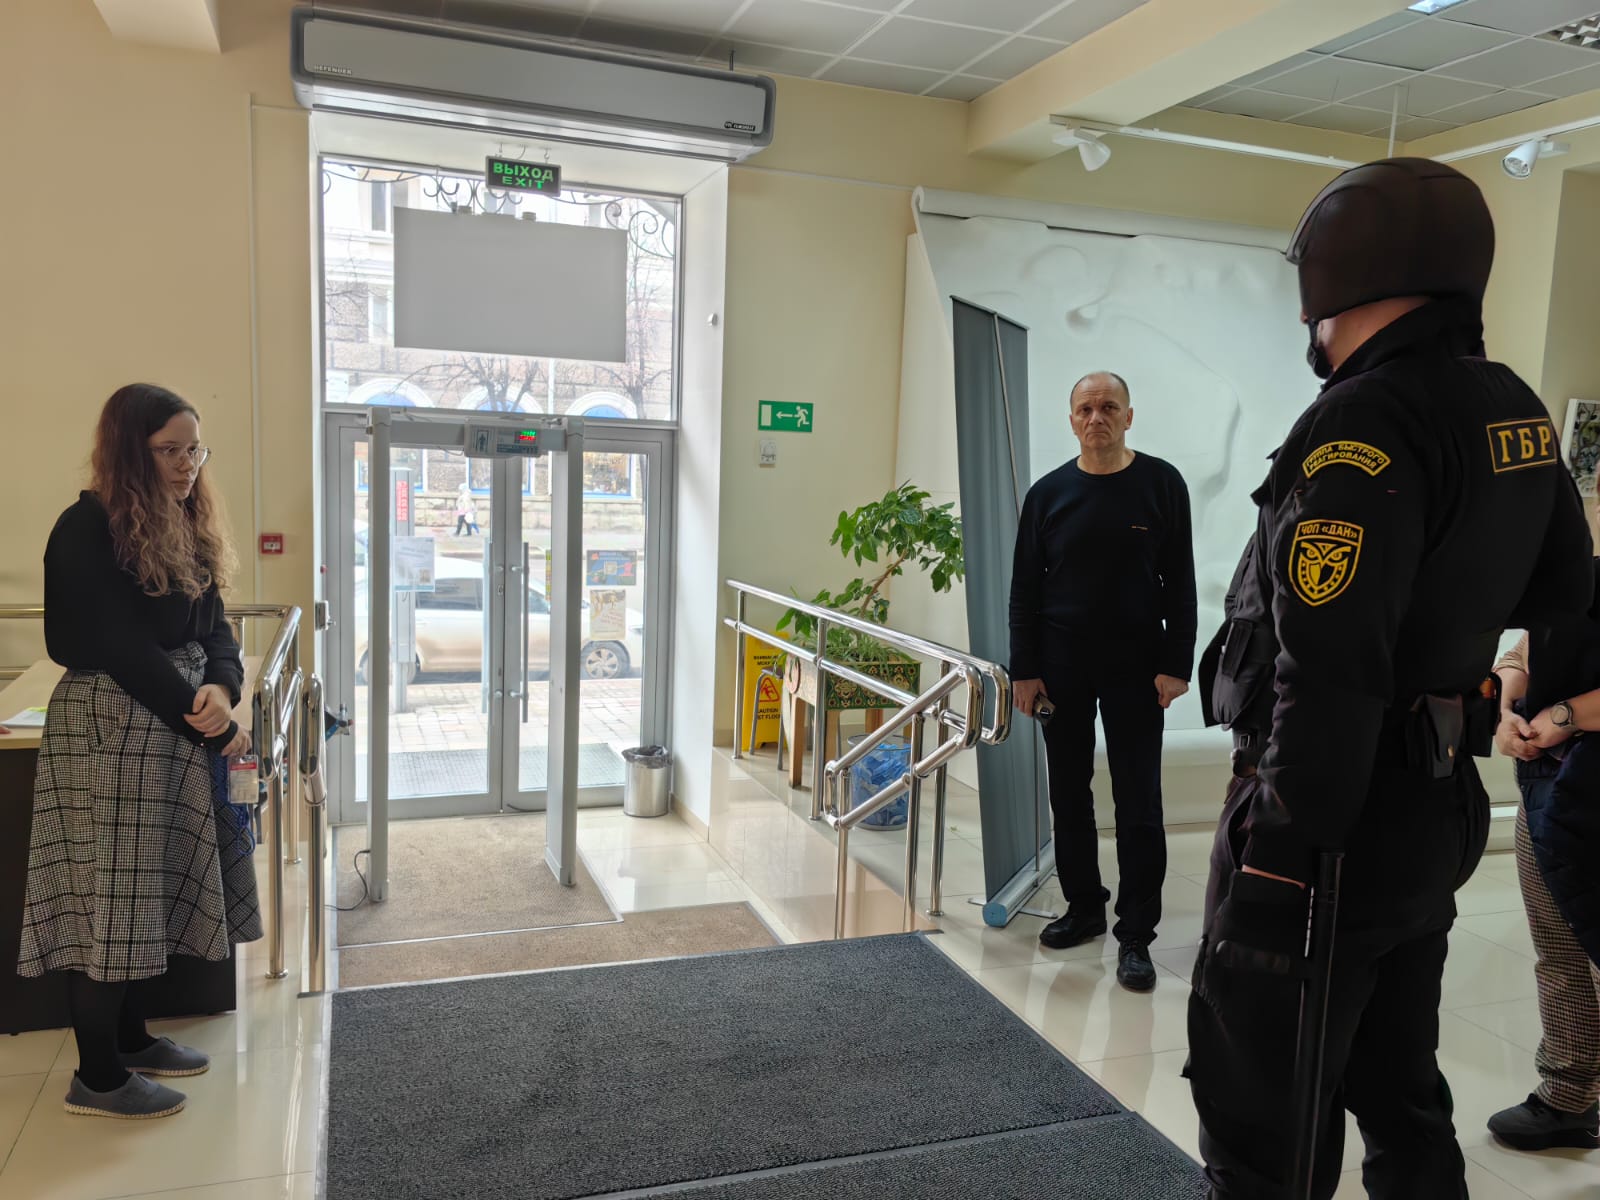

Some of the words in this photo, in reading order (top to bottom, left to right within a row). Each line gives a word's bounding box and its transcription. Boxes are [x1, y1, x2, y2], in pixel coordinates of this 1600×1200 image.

[493, 162, 553, 182] ВЫХОД
[502, 176, 544, 189] EXIT
[1497, 425, 1551, 463] ГБР
[1306, 446, 1333, 467] ГРУППА
[1338, 444, 1385, 464] БЫСТРОГО
[1309, 451, 1377, 471] РЕАГИРОВАНИЯ
[1301, 524, 1320, 535] ЧОП
[1321, 524, 1358, 538] «ДАН»
